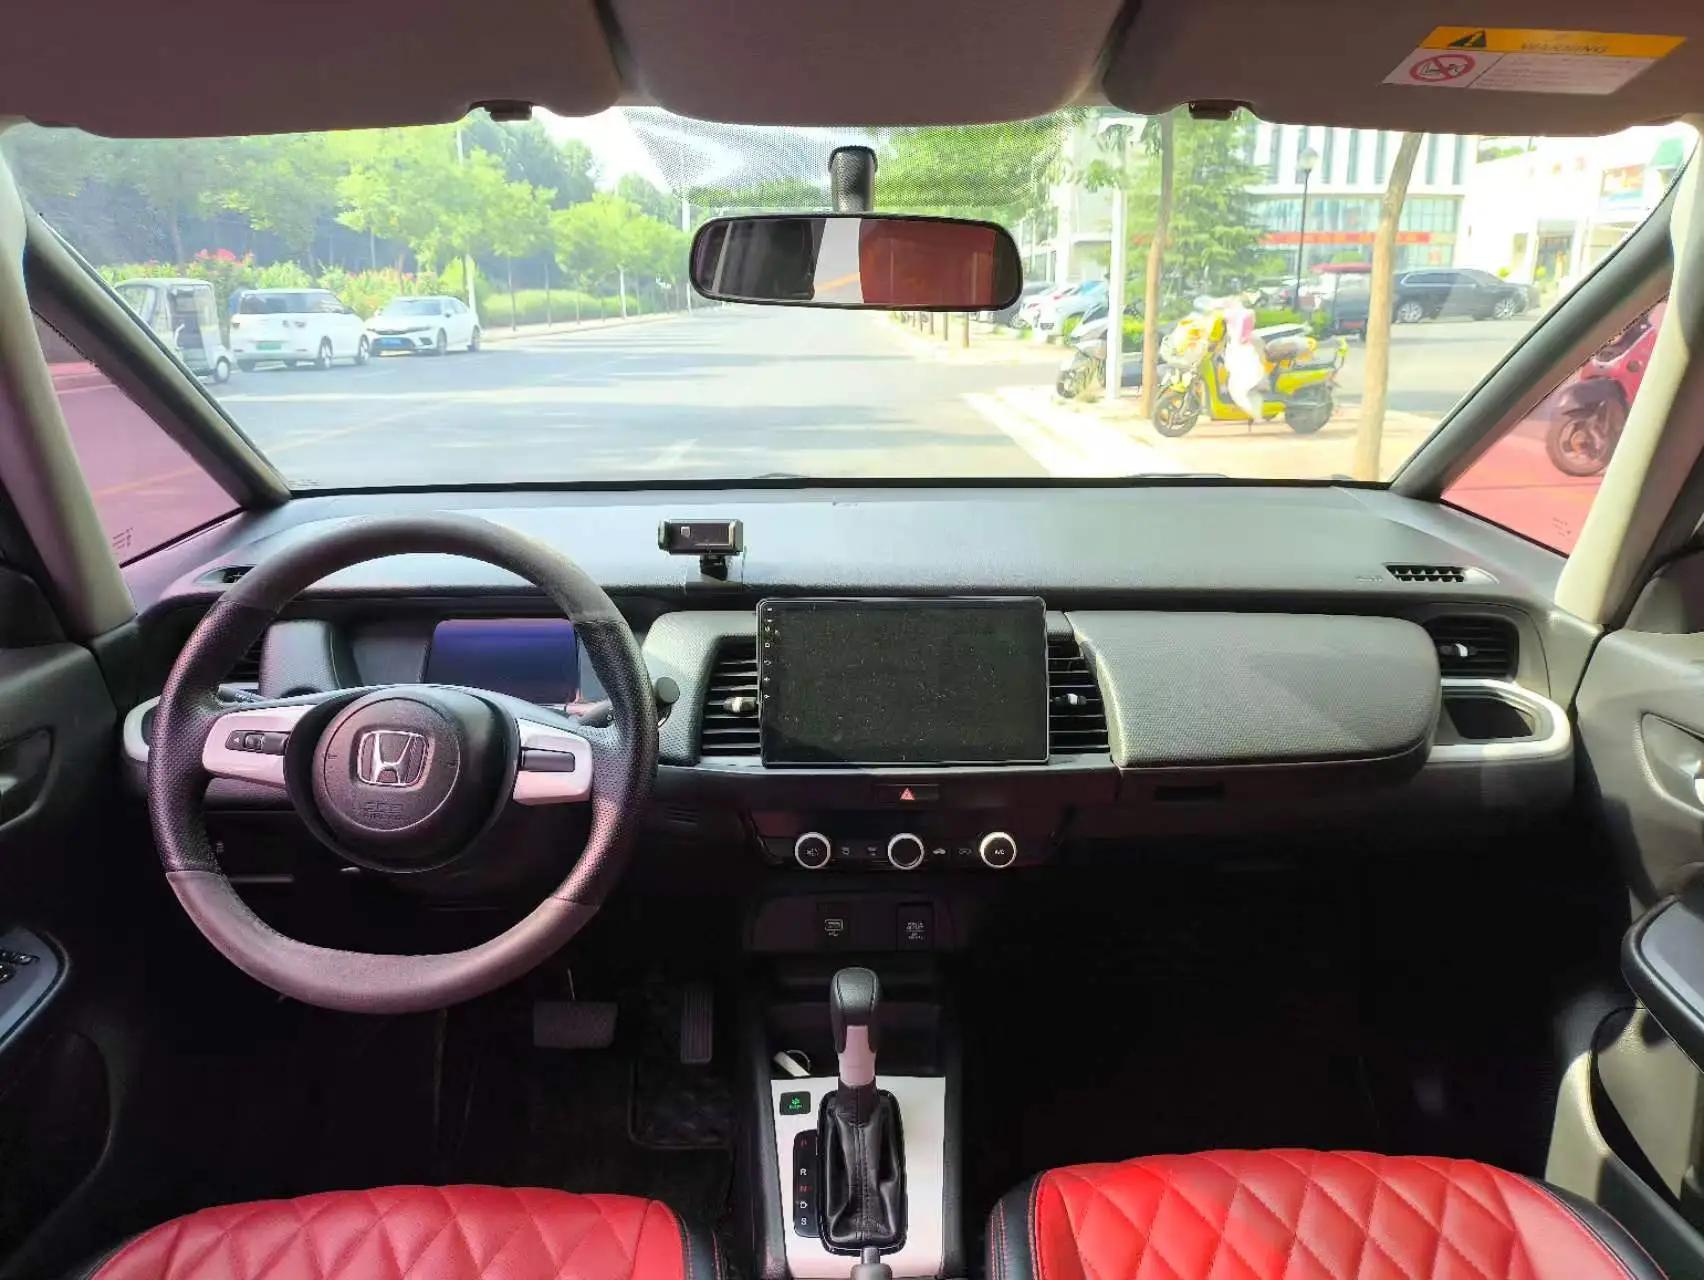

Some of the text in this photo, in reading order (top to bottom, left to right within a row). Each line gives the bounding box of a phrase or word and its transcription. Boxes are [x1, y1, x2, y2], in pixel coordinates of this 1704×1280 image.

[800, 1168, 807, 1176] R
[800, 1201, 808, 1209] D
[801, 1217, 807, 1225] S
